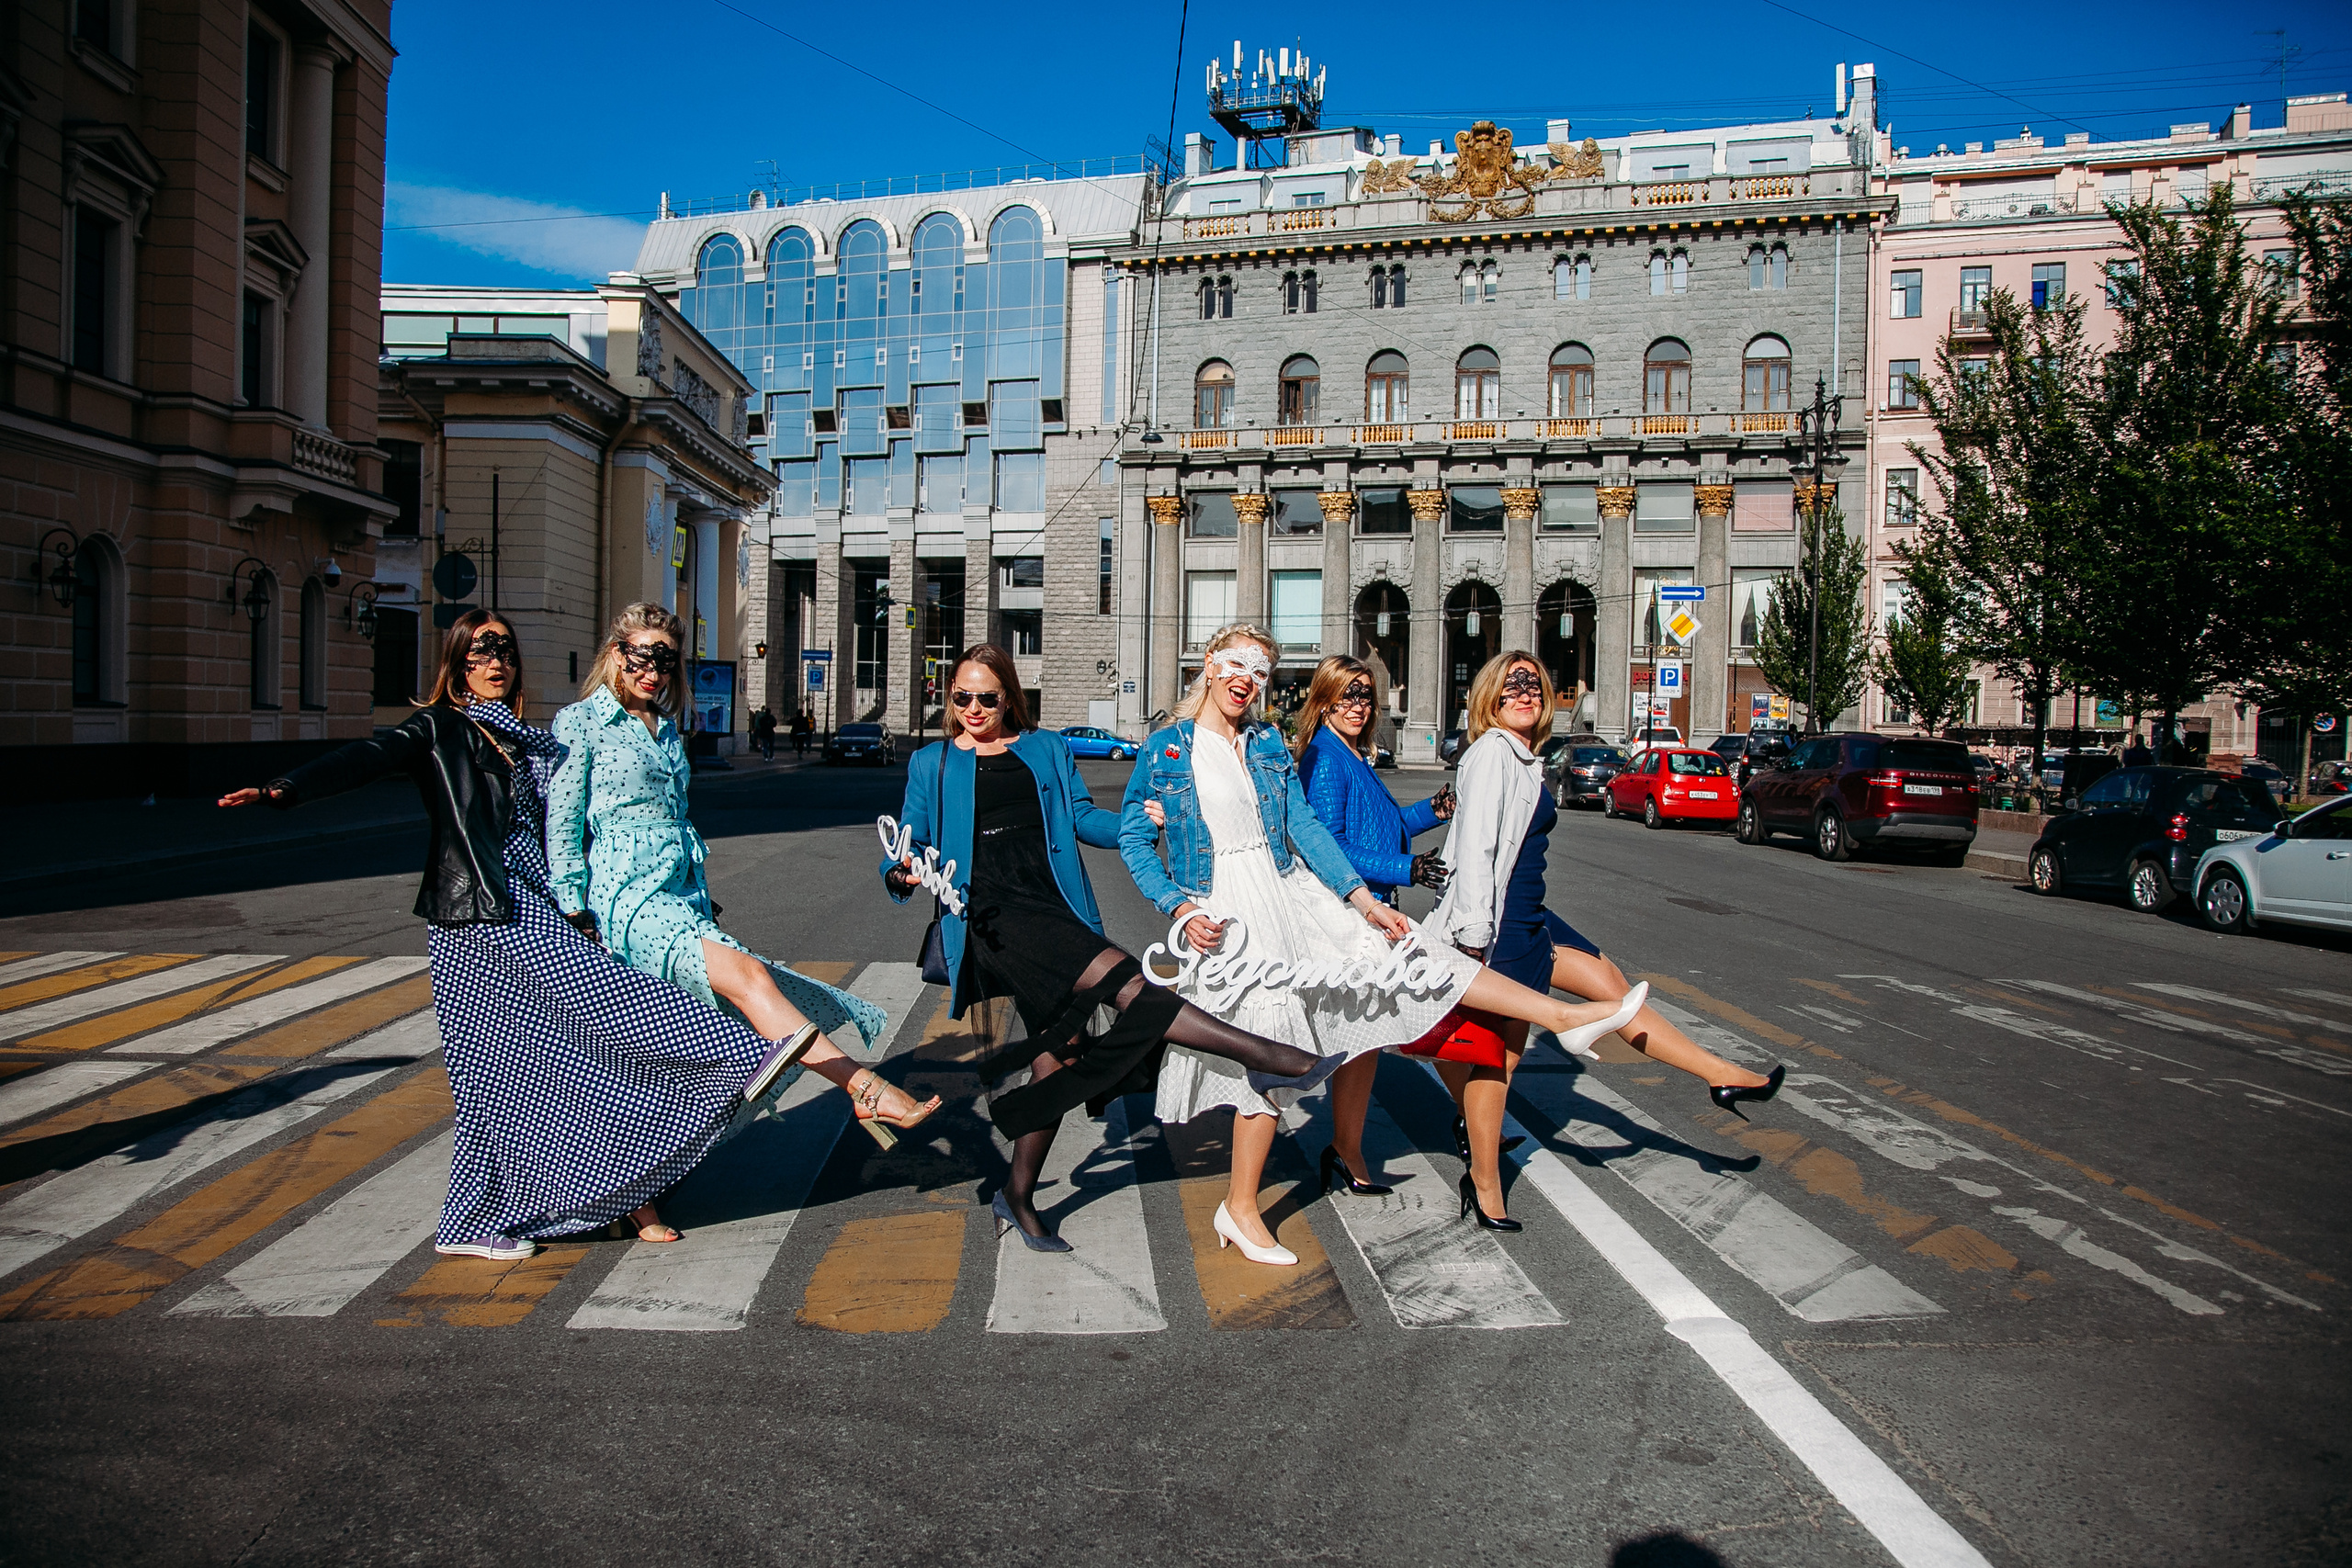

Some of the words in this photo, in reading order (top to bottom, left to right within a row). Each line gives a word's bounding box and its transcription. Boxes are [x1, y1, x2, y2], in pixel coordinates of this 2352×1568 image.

[812, 671, 820, 682] P
[1665, 670, 1676, 685] P
[1909, 772, 1962, 780] DISCOVERY
